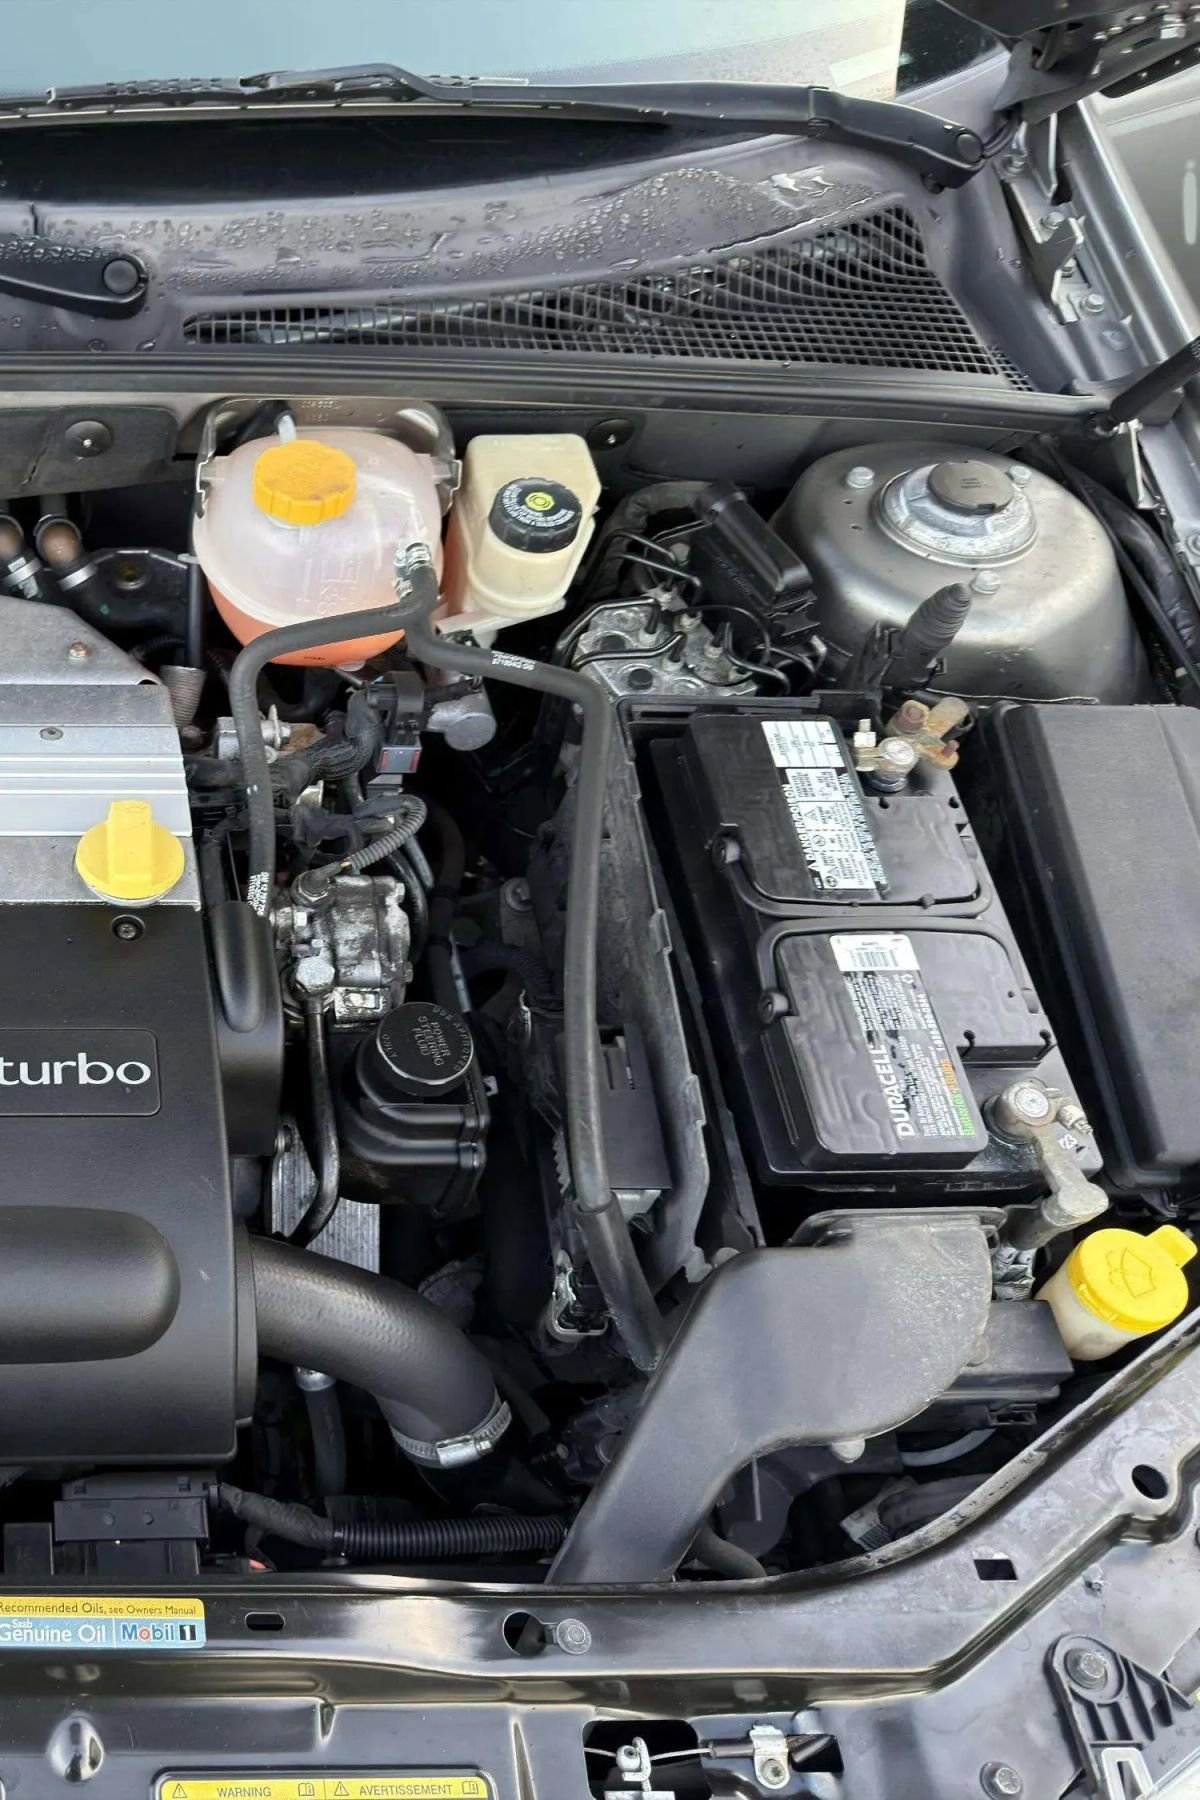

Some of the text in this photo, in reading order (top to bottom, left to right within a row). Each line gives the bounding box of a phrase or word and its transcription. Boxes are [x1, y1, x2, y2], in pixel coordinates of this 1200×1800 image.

[382, 1033, 398, 1058] ONLY
[411, 1027, 431, 1056] FLUID
[417, 1015, 445, 1066] STEERING
[430, 1021, 451, 1057] POWER
[452, 1022, 471, 1071] APPROVED
[870, 1043, 916, 1138] DURACELL
[81, 1602, 107, 1615] Oils,
[108, 1606, 124, 1614] see
[126, 1604, 163, 1614] Owners
[165, 1605, 196, 1615] Manual
[11, 1618, 33, 1629] Saab
[78, 1622, 107, 1643] Oil
[121, 1622, 195, 1641] Mobil 1
[216, 1784, 453, 1798] WARNING AVERTISSEMENT
